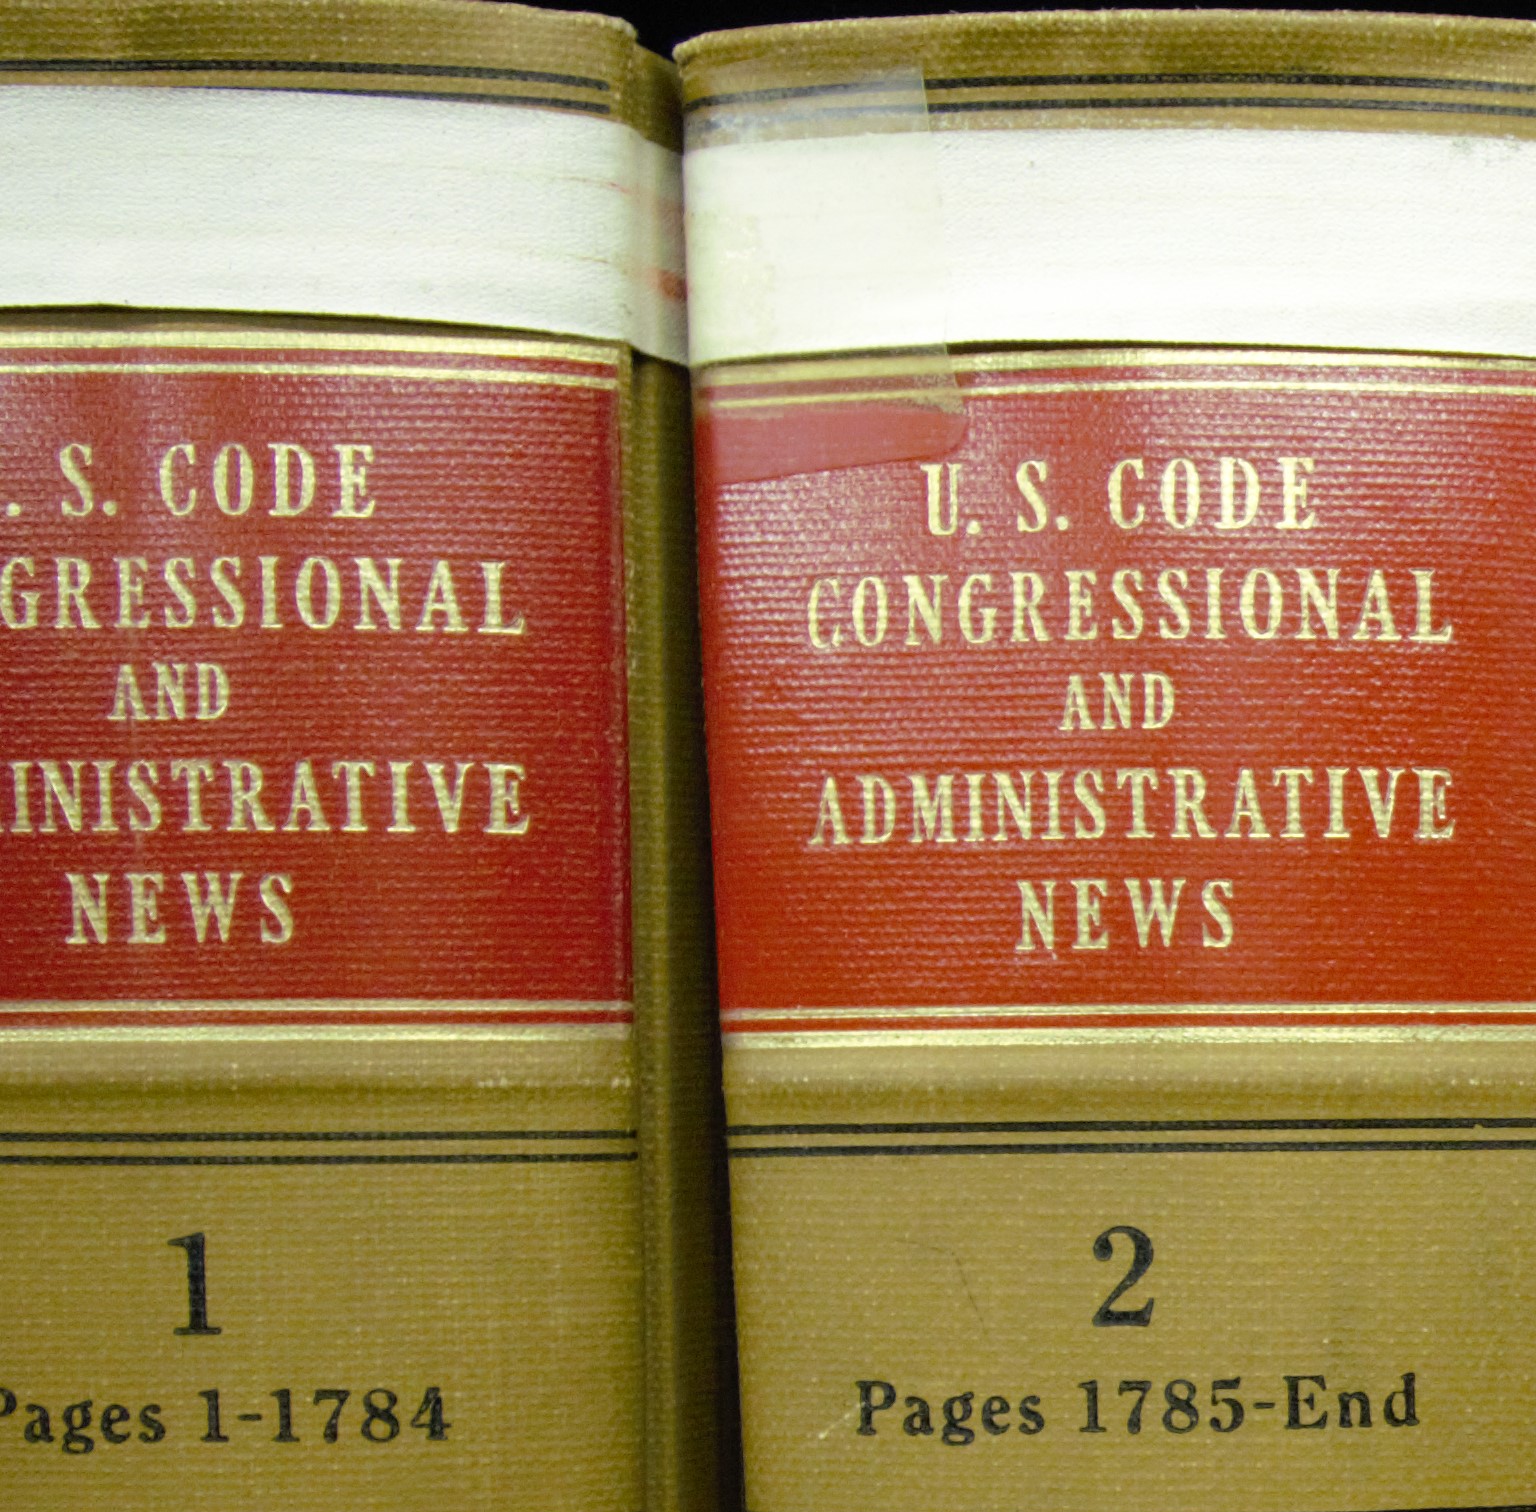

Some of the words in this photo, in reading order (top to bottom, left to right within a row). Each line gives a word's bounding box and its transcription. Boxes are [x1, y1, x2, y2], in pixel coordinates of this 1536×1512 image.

[59, 443, 117, 516] S.
[158, 442, 376, 518] CODE
[919, 463, 981, 537] U.
[1015, 459, 1070, 533] S.
[1106, 456, 1318, 532] CODE
[805, 567, 1454, 649] CONGRESSIONAL
[107, 663, 230, 721] AND
[1058, 672, 1176, 731] AND
[0, 760, 530, 835] INISTRATIVE
[807, 766, 1456, 846] ADMINISTRATIVE
[64, 872, 295, 945] NEWS
[1015, 878, 1235, 951] NEWS
[167, 1232, 222, 1336] 1
[1092, 1225, 1155, 1328] 2
[199, 1386, 451, 1443] 1-1784
[855, 1378, 1045, 1447] Pages
[1077, 1371, 1420, 1435] 1785-End
